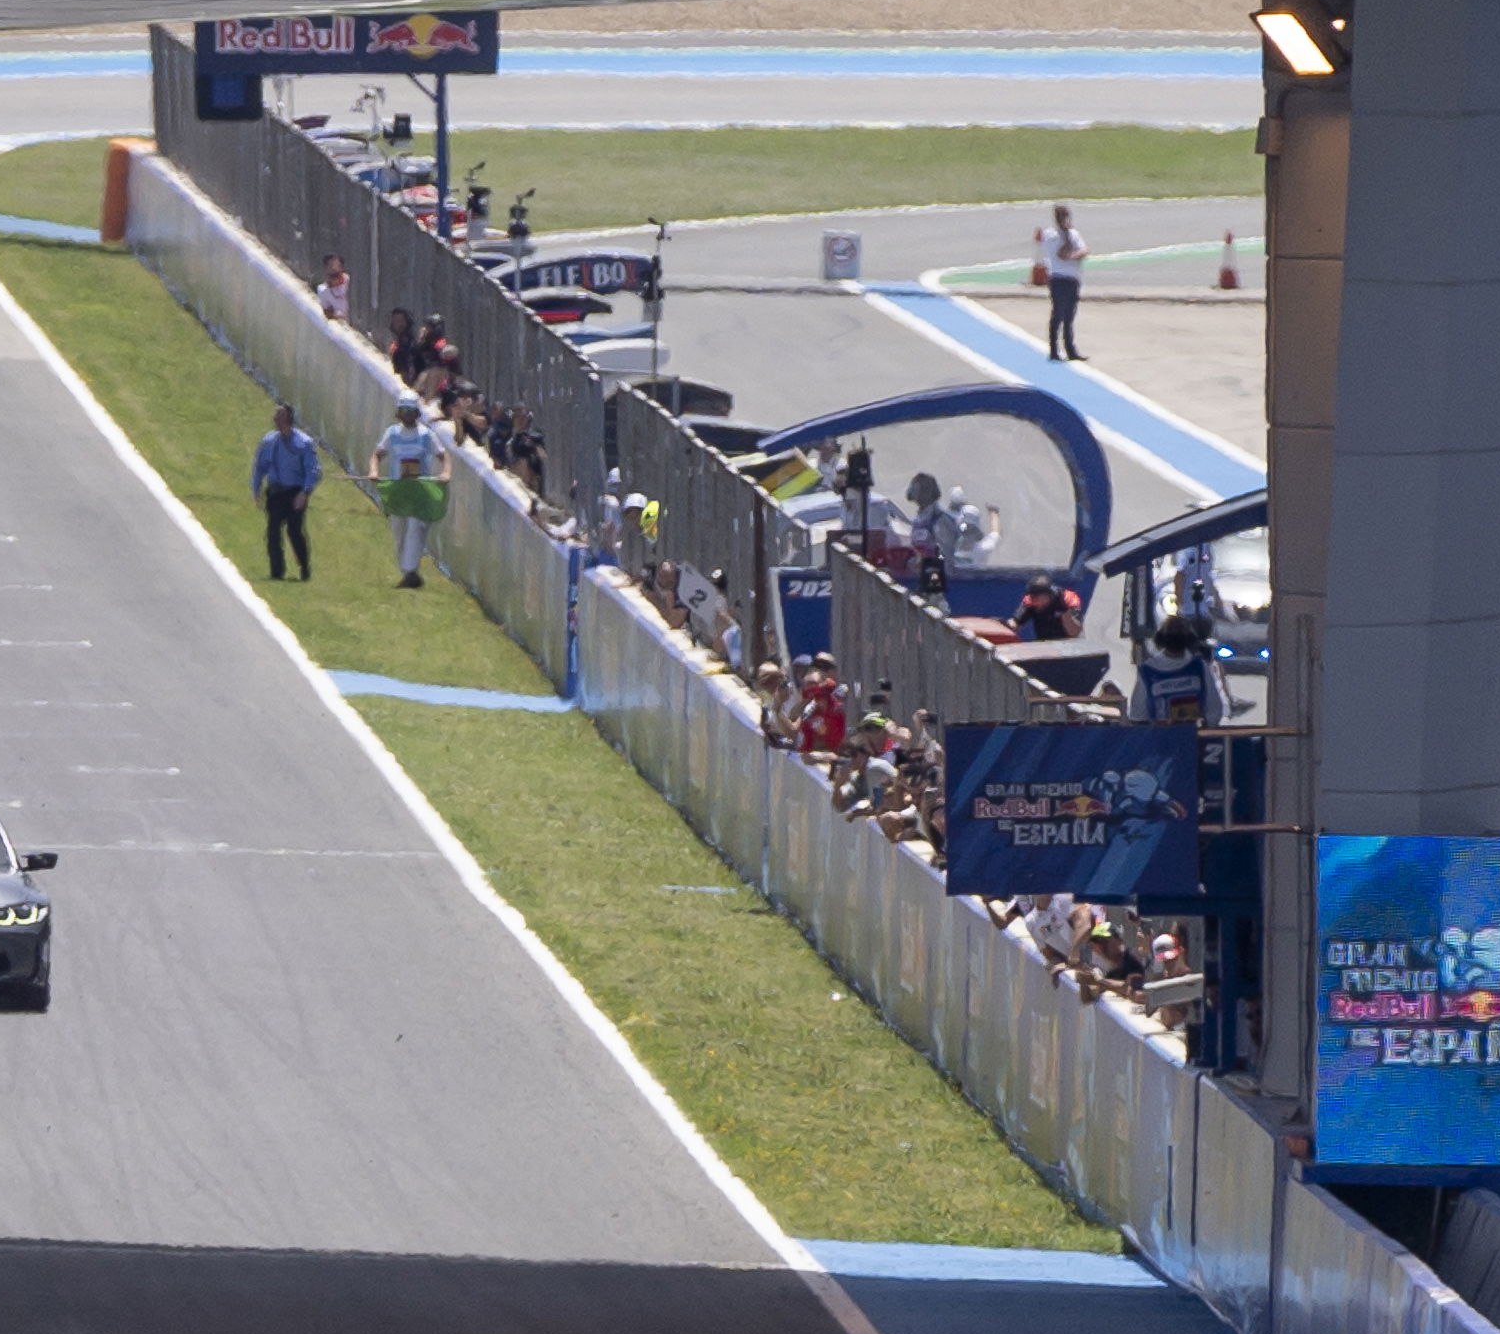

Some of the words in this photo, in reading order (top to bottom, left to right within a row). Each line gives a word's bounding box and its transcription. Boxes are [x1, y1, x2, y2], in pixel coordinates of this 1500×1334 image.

[215, 17, 281, 54] Red
[287, 16, 356, 54] Bull
[974, 797, 1011, 818] Red
[1012, 797, 1050, 818] Bull
[1014, 817, 1105, 845] ESPAÑA
[1327, 940, 1409, 966] GRAN
